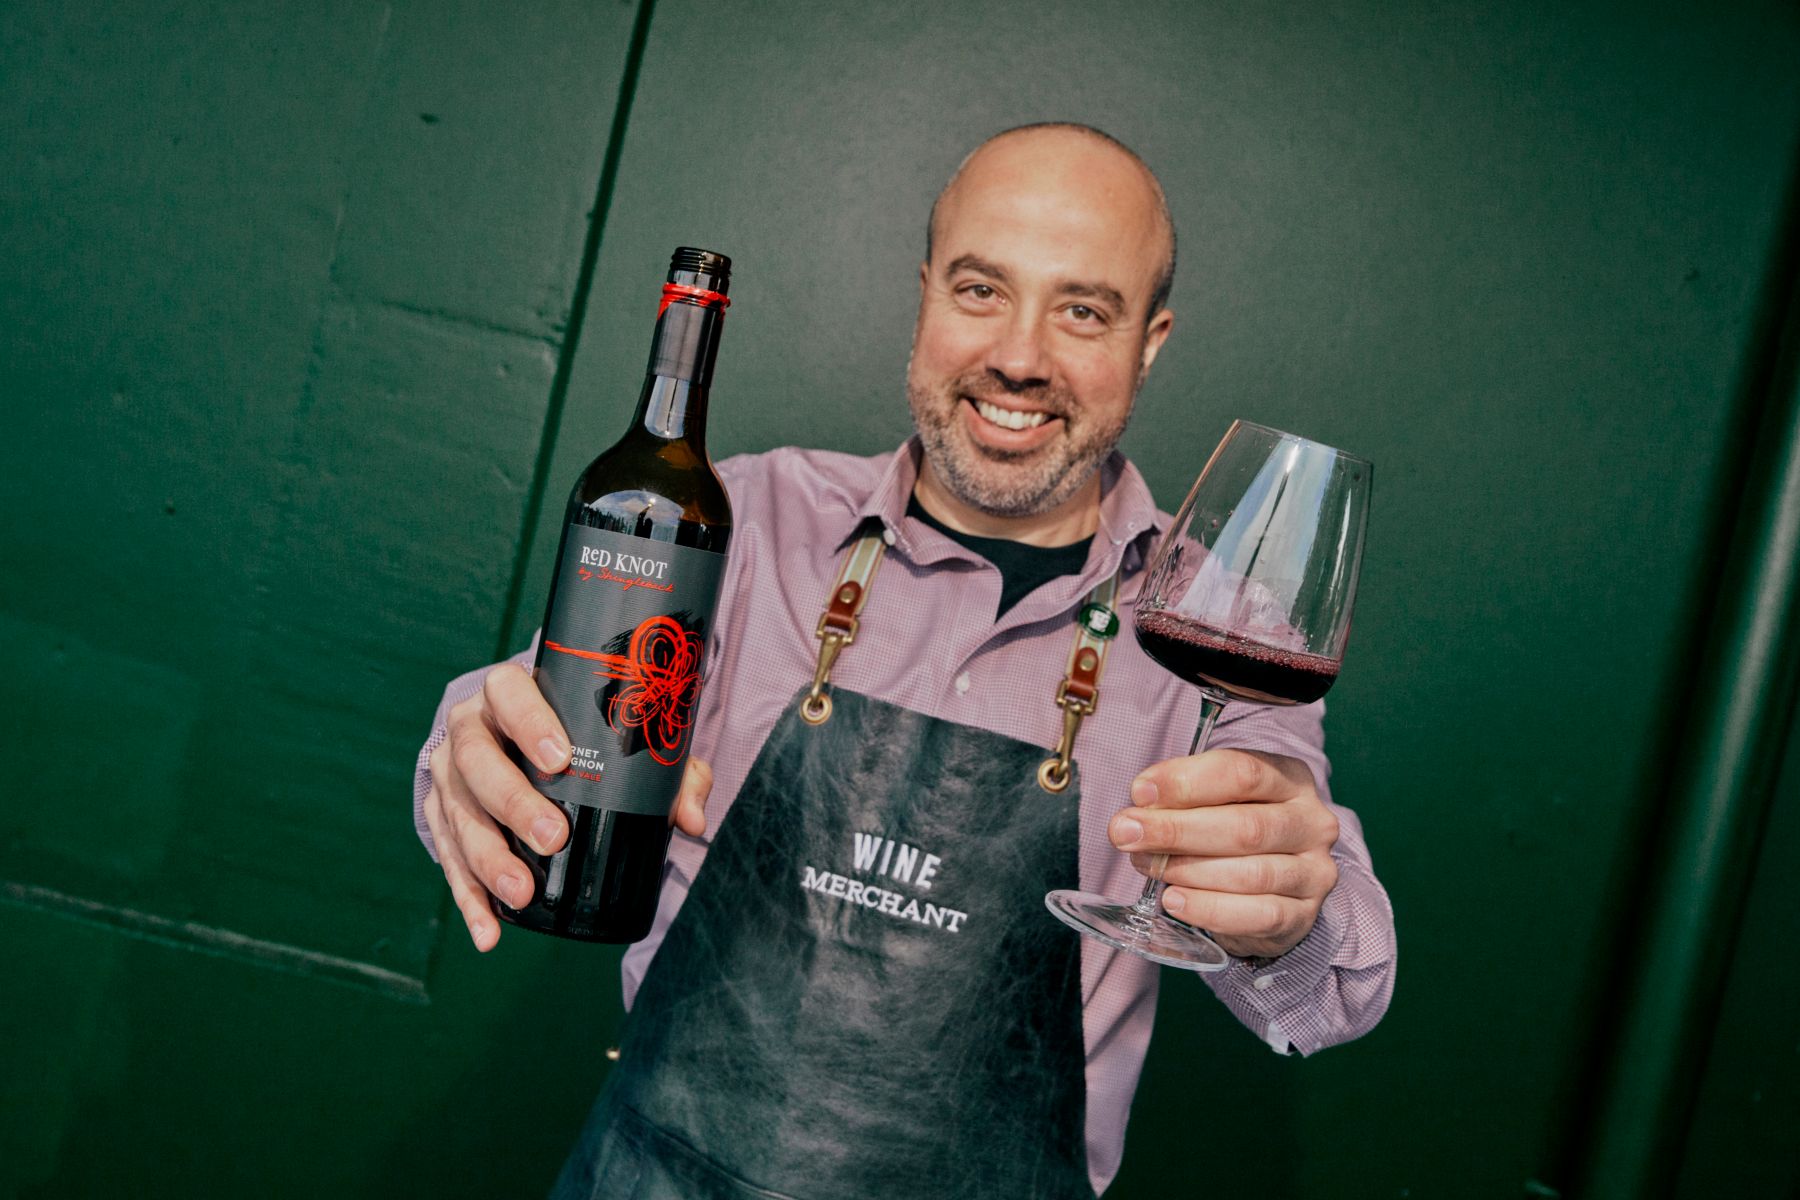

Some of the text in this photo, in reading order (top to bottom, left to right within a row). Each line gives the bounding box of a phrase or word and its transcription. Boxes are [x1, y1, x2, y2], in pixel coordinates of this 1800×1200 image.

[613, 552, 668, 579] KNOT
[577, 566, 675, 592] by Shingleback
[570, 745, 599, 760] RNET
[578, 769, 602, 783] VALE
[853, 832, 942, 890] WINE
[801, 866, 968, 933] MERCHANT
